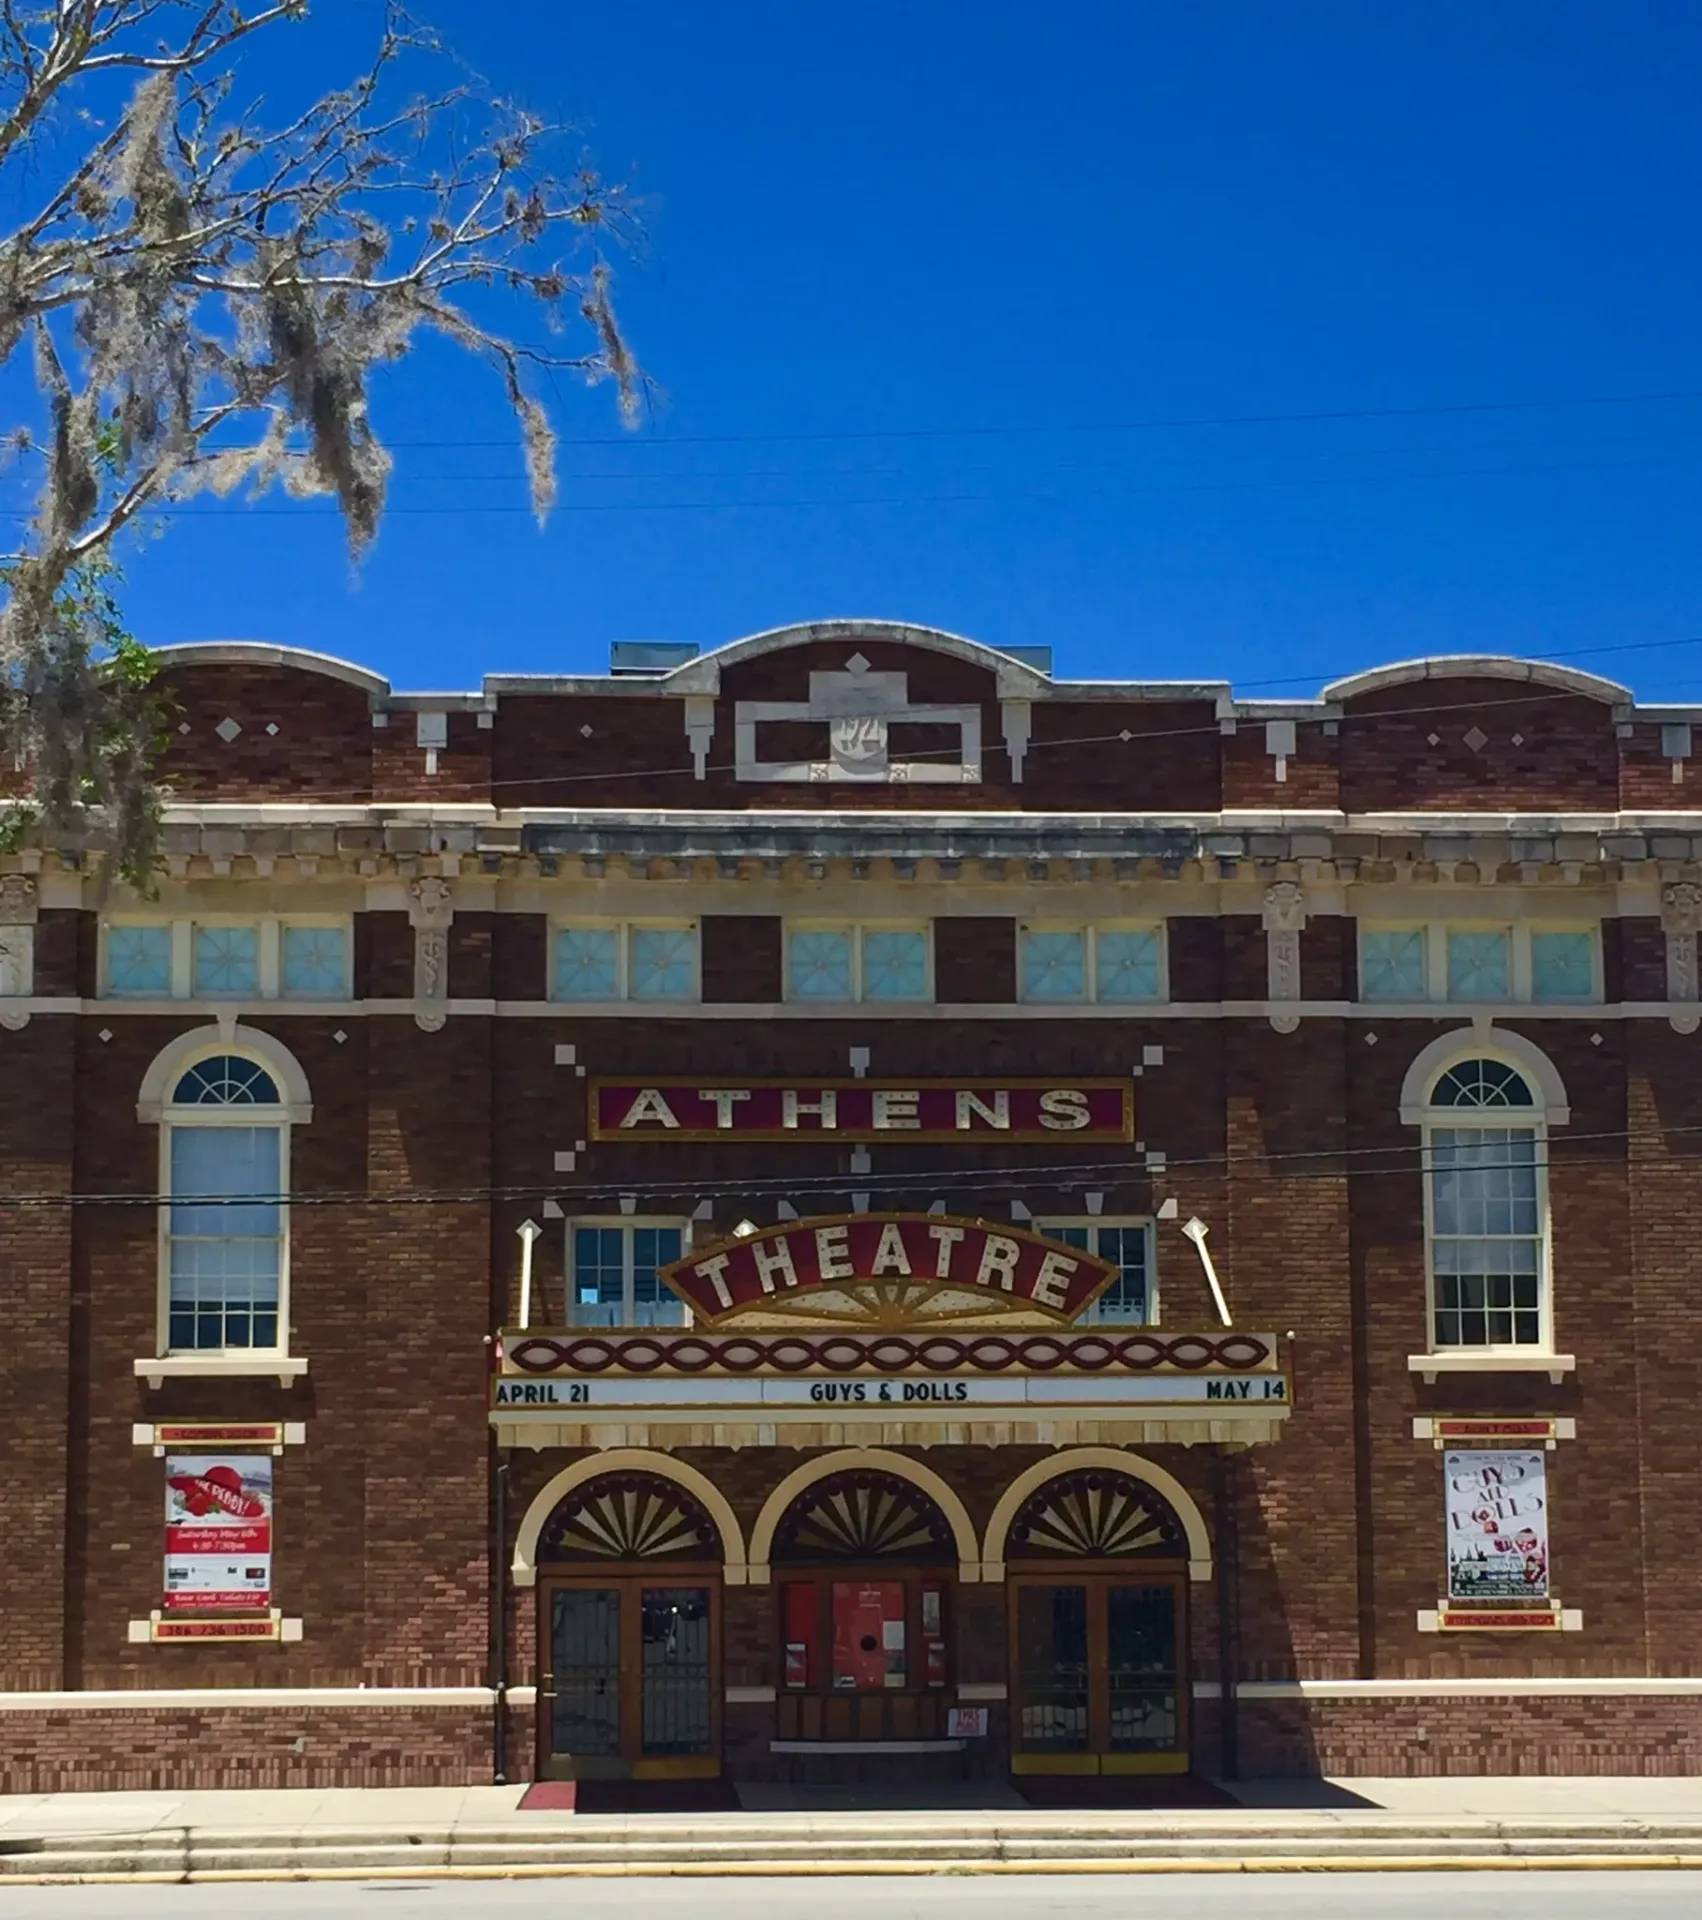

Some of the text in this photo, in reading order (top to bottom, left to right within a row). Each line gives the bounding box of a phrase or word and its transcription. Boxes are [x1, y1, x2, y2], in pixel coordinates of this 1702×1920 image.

[619, 1088, 1092, 1130] ATHENS
[693, 1222, 1080, 1309] THEATRE
[496, 1384, 589, 1403] APRIL 21
[810, 1382, 968, 1401] GUYS & DOLLS
[1206, 1380, 1285, 1399] MAY 14
[1452, 1462, 1525, 1494] GUYS
[1451, 1491, 1543, 1531] DOLLS
